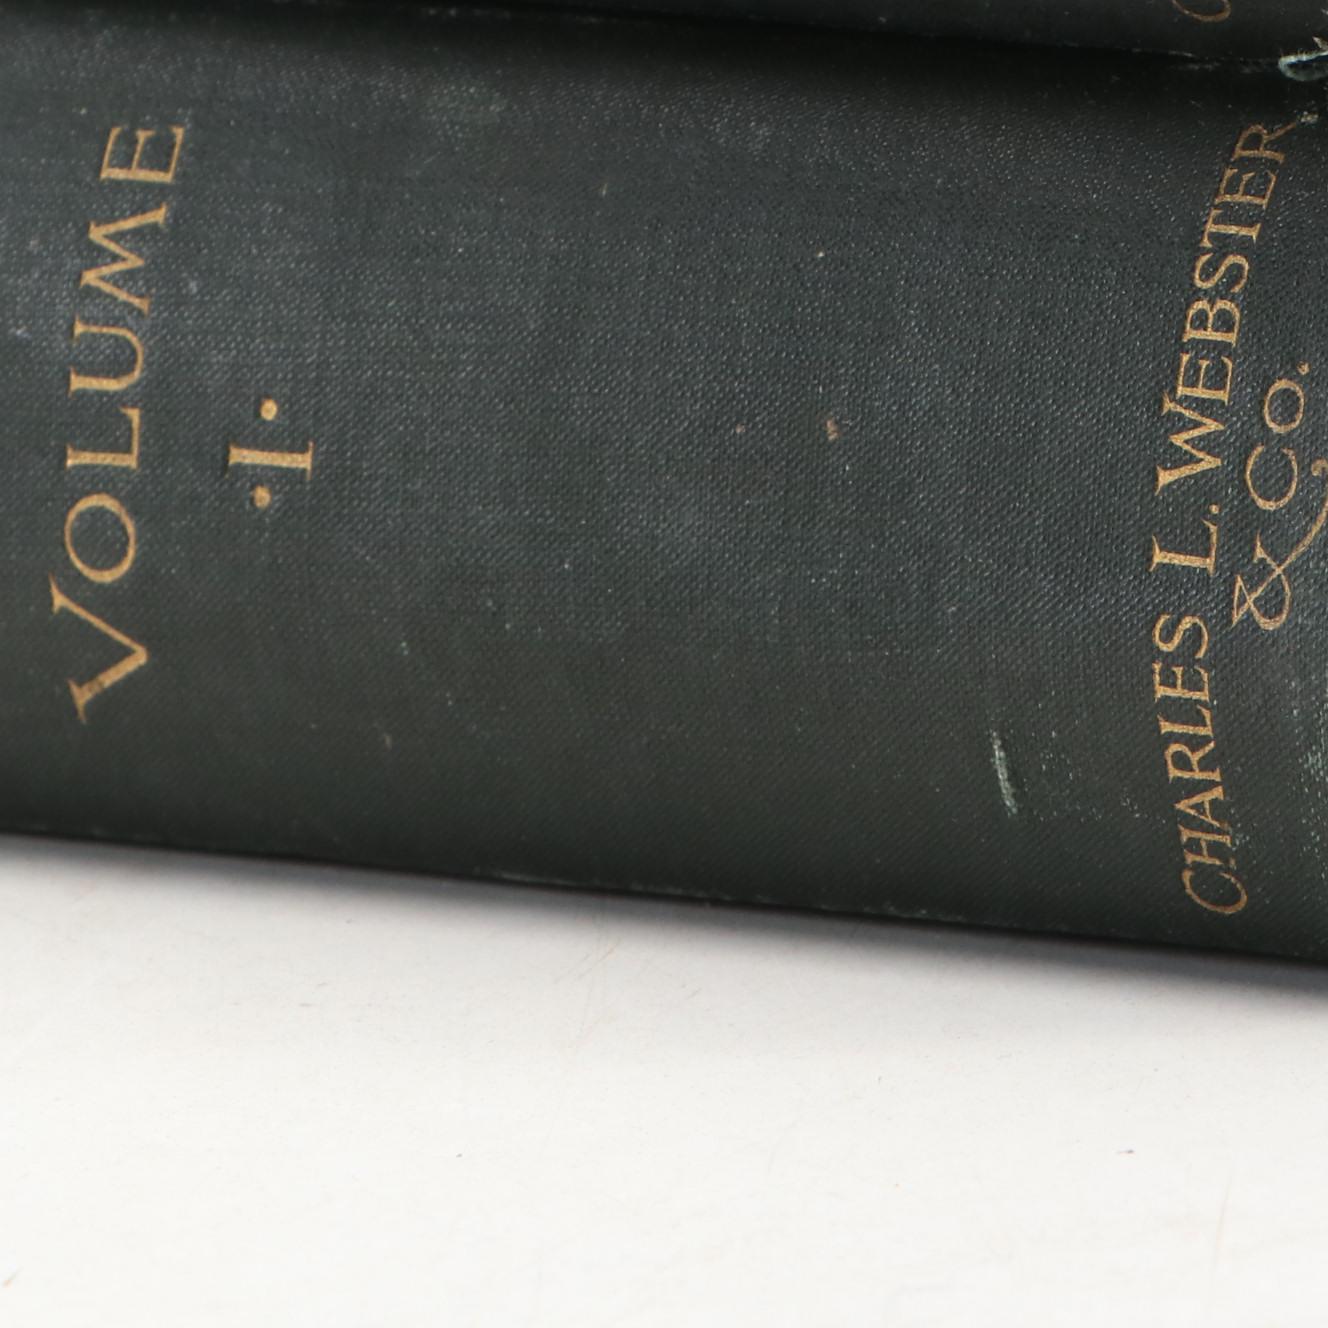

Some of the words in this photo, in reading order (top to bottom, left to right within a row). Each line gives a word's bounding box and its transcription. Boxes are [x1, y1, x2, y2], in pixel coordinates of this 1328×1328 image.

[49, 124, 185, 725] VOLUME
[1154, 121, 1298, 495] WEBSTER
[1244, 361, 1311, 513] CO.
[1149, 500, 1221, 577] L.
[1152, 611, 1249, 916] CHARLES
